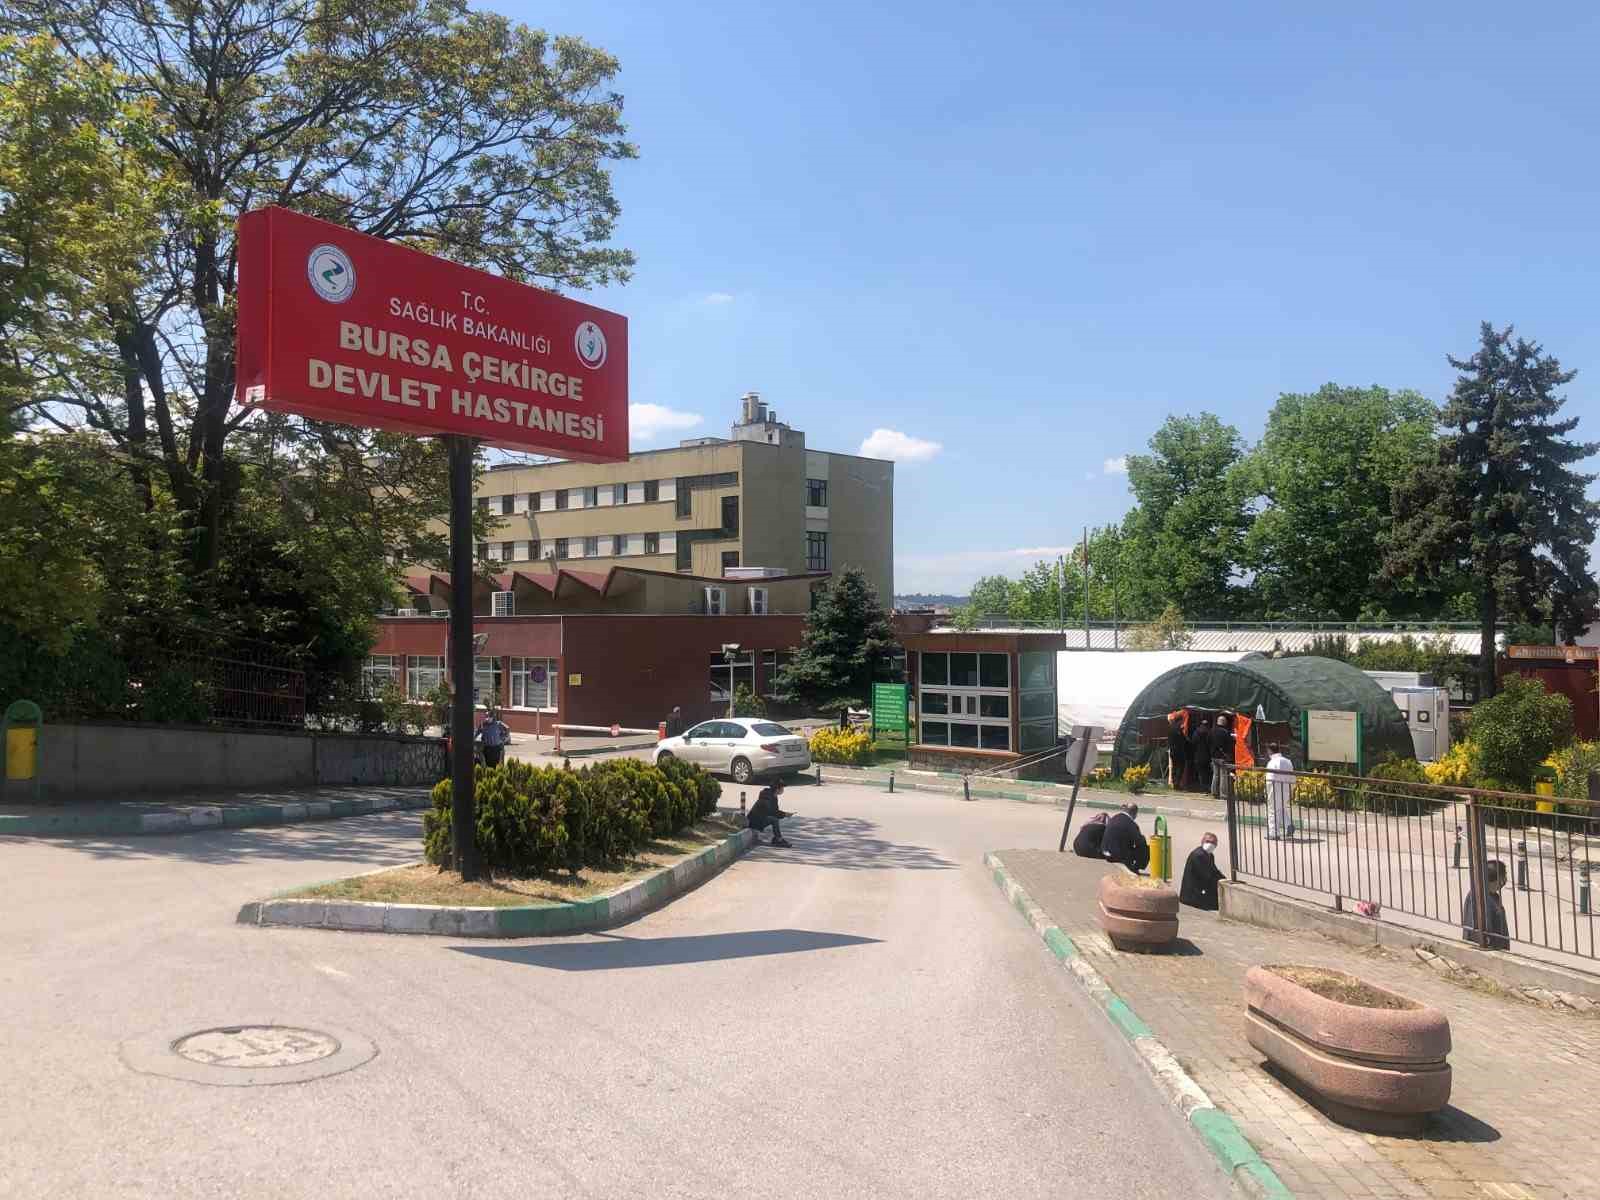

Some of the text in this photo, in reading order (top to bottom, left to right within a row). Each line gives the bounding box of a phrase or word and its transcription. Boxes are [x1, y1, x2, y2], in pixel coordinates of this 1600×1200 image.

[389, 297, 551, 355] SAĞLIK BAKANLIĞI
[461, 291, 490, 315] T.C.
[340, 320, 584, 401] BURSA ÇEKİRGE
[308, 358, 604, 441] DEVLET HASTANESİ
